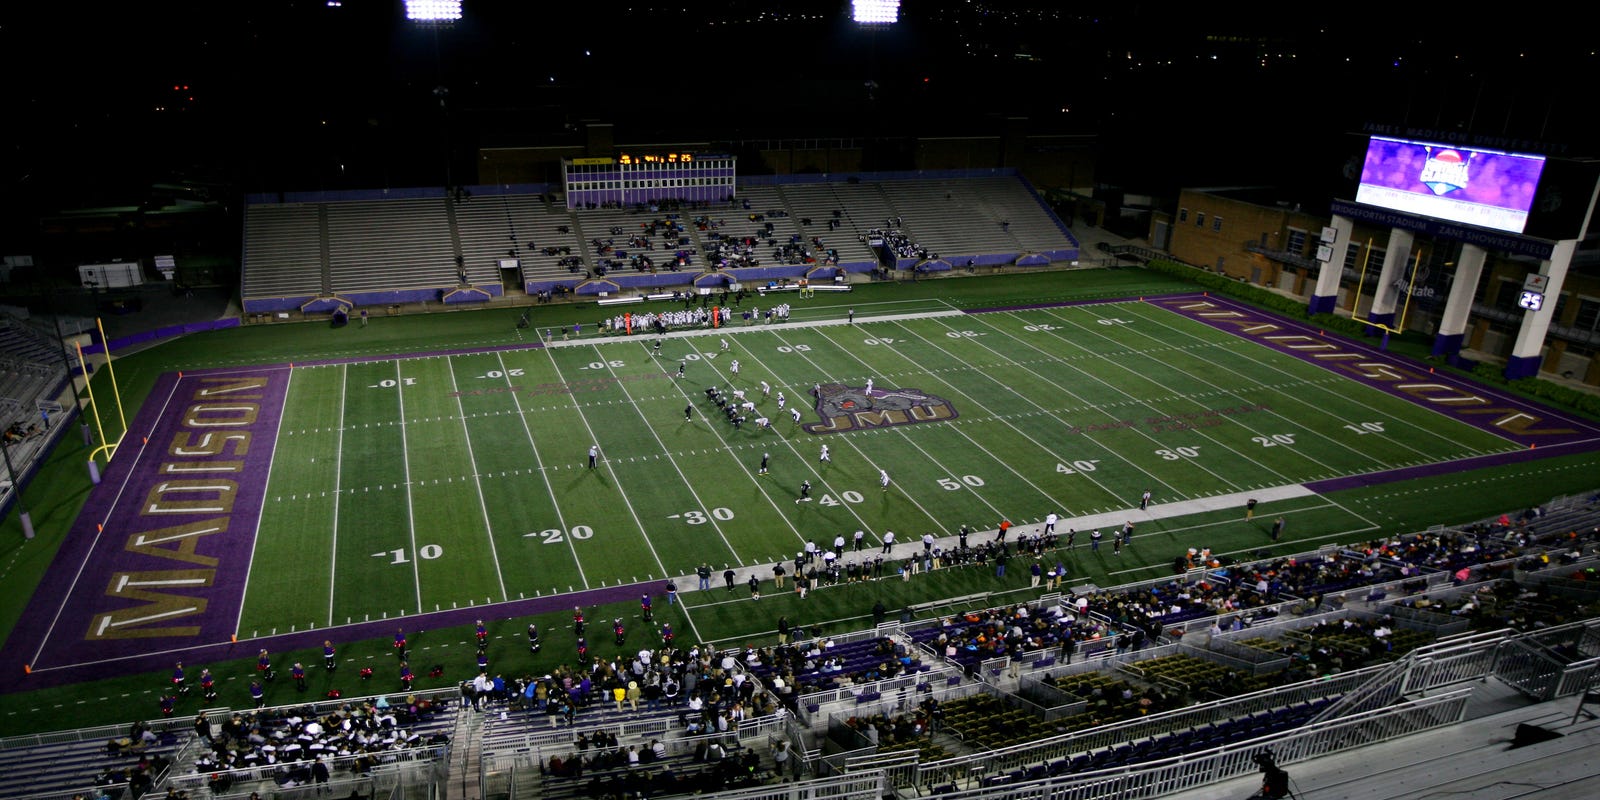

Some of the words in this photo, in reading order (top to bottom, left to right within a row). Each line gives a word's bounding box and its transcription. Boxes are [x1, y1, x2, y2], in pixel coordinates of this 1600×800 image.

[1363, 121, 1400, 135] JAMES
[1406, 127, 1469, 143] MADISON
[1474, 135, 1569, 153] UNIVERSITY
[681, 154, 691, 162] 25
[1330, 203, 1386, 222] BRIDGEFORTH
[1387, 215, 1427, 231] STADIUM
[1439, 225, 1465, 238] ZANE
[1466, 231, 1517, 249] SHOWKER
[1520, 242, 1550, 256] FIELD
[1393, 279, 1434, 297] Allstate
[1520, 292, 1541, 310] 25
[1164, 299, 1580, 437] MADISON
[804, 402, 956, 434] JMU
[1343, 421, 1384, 435] 10
[1251, 432, 1296, 448] 20
[1154, 446, 1199, 461] 30
[1056, 459, 1097, 476] 40
[936, 474, 985, 491] 50
[819, 490, 864, 507] 40
[84, 377, 269, 641] MADISON
[686, 507, 735, 526] 30
[540, 524, 594, 544] 20
[390, 543, 443, 565] 10
